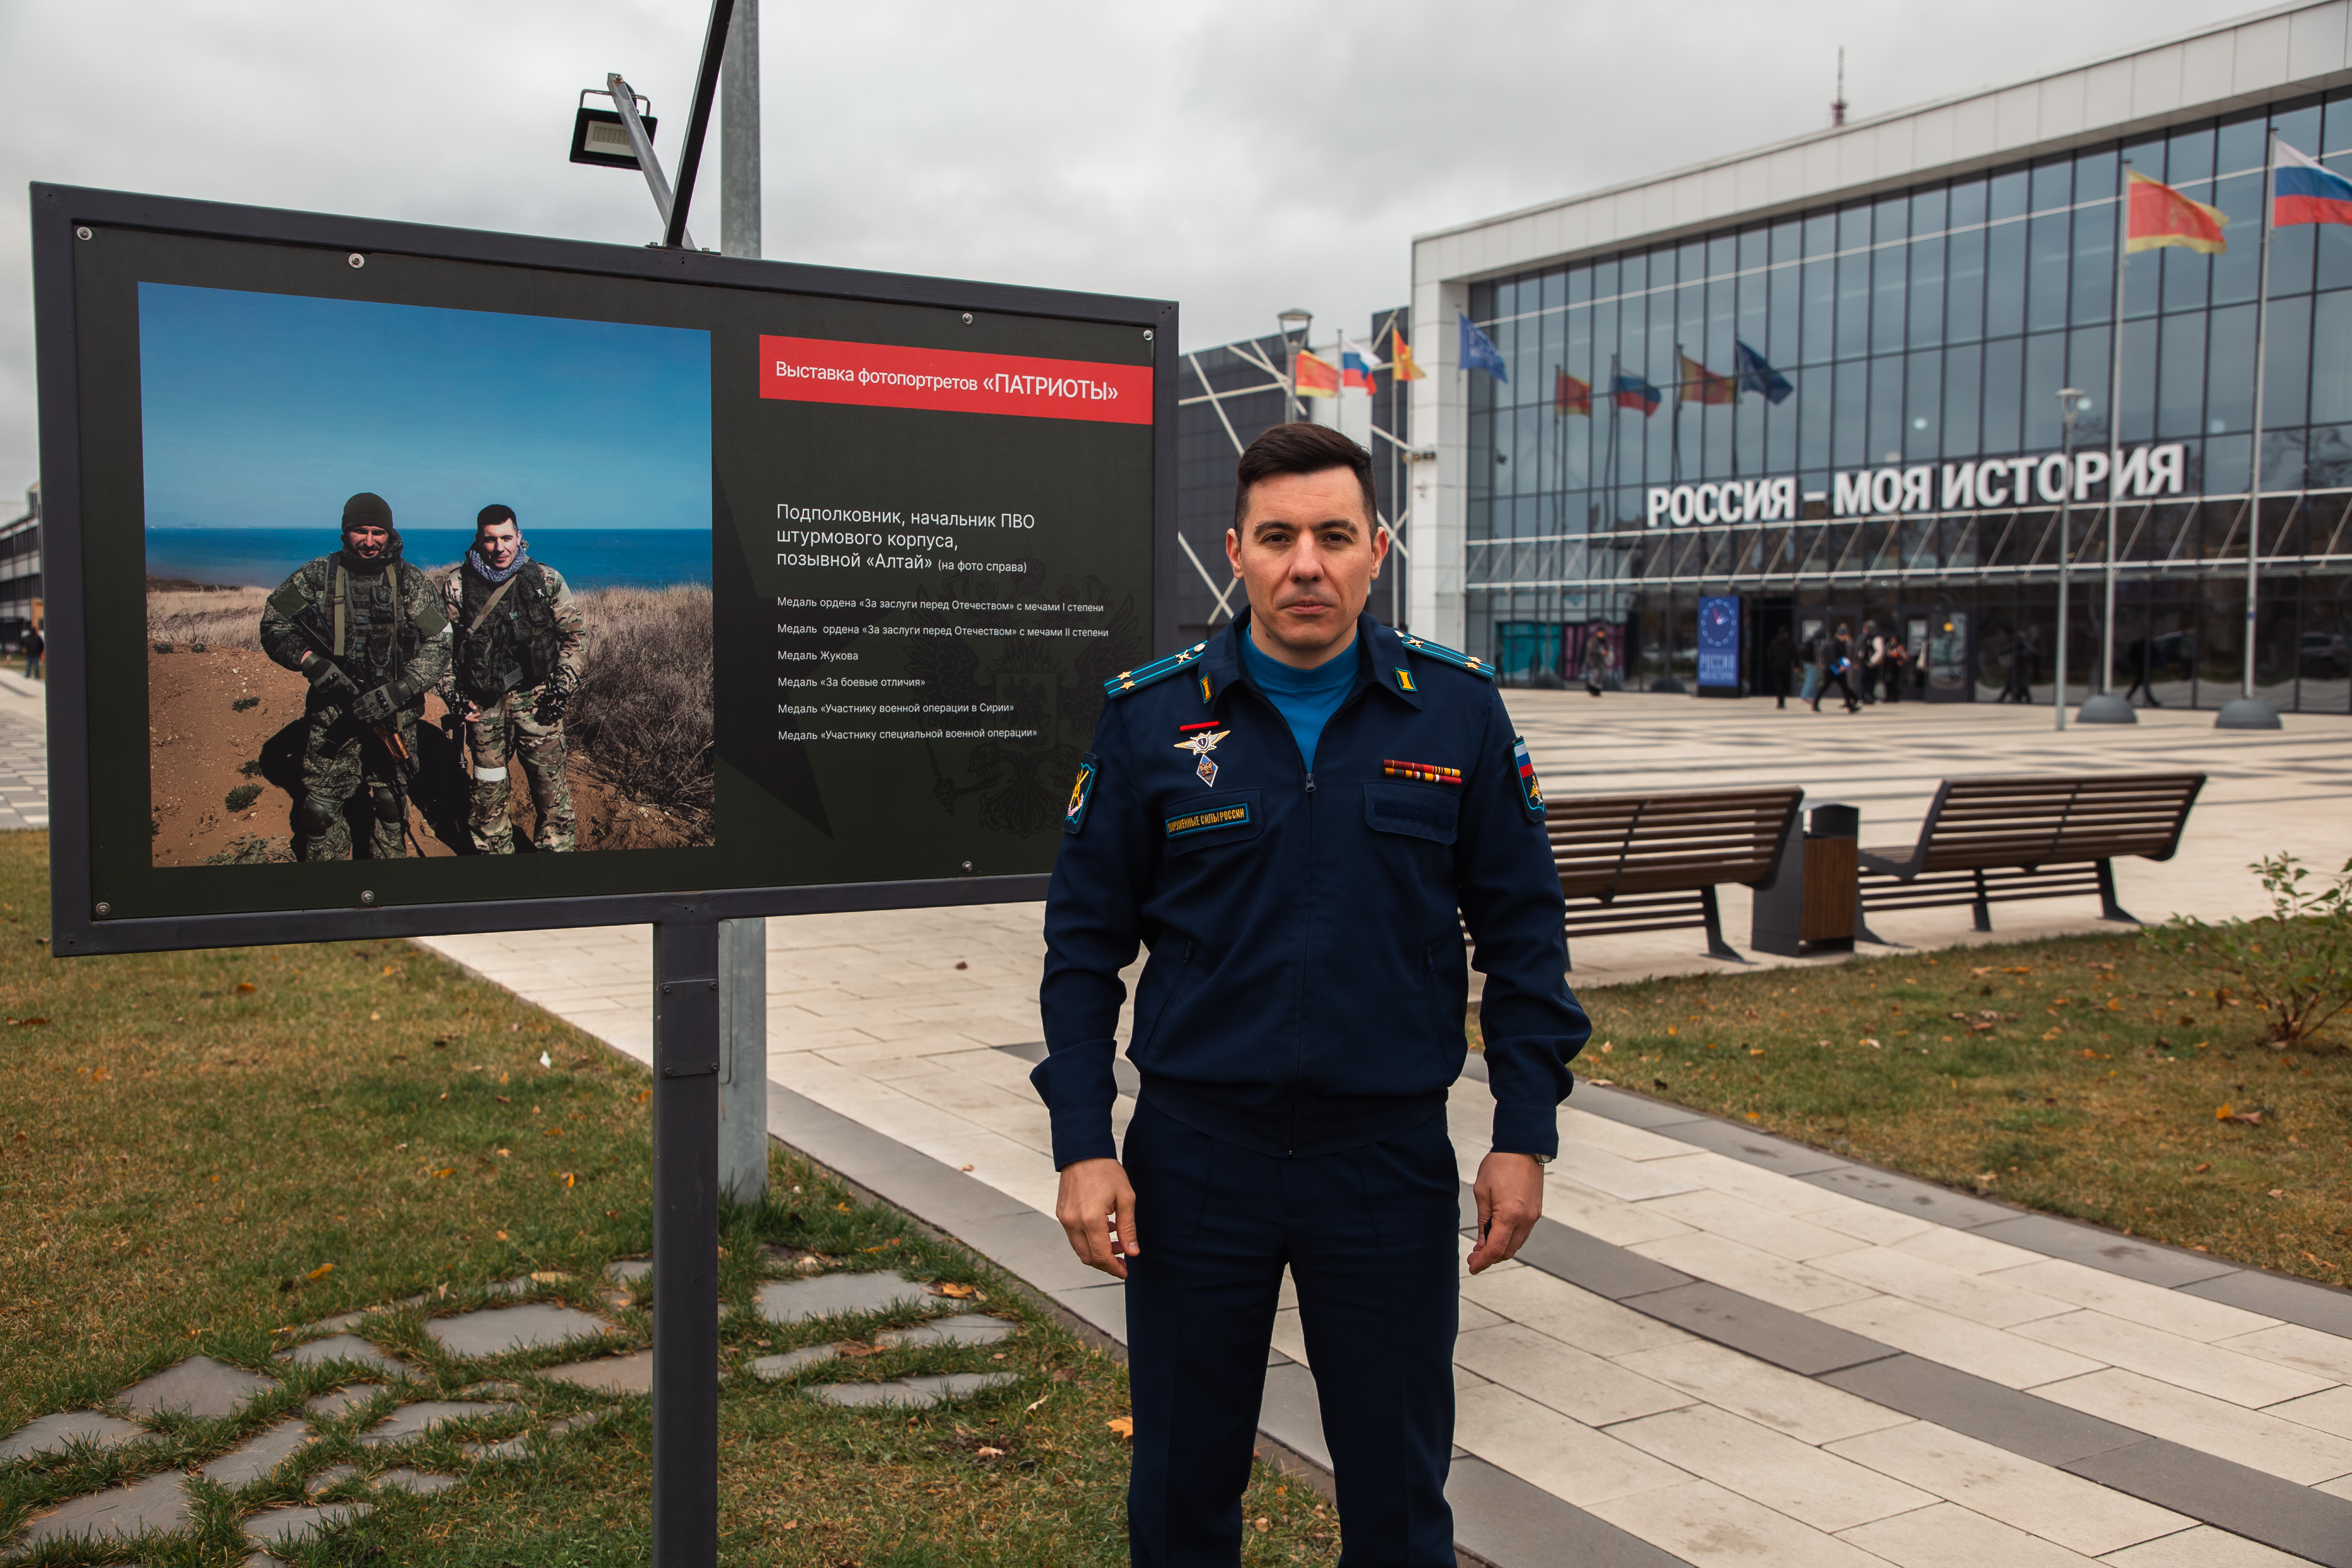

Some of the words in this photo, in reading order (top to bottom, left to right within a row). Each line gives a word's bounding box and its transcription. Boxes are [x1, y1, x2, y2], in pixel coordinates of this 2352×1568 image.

[776, 361, 854, 382] Выставка
[858, 368, 978, 392] фотопортретов
[983, 373, 1118, 400] «ПАТРИОТЫ»
[1648, 476, 1796, 527] РОССИЯ
[1834, 466, 1933, 515] МОЯ
[1942, 444, 2185, 510] ИСТОРИЯ
[777, 504, 905, 527] Подполковник,
[911, 513, 996, 527] начальник
[1001, 513, 1035, 529] ПВО
[777, 530, 882, 547] штурмового
[888, 534, 958, 551] корпуса,
[778, 551, 860, 567] позывной
[867, 553, 932, 569] «Алтай»
[938, 559, 954, 571] (на
[957, 560, 983, 572] фото
[986, 562, 1027, 574] справа)
[778, 597, 817, 608] Медаль
[820, 600, 856, 609] ордена
[859, 598, 876, 608] «За
[879, 600, 917, 610] заслуги
[920, 601, 949, 611] перед
[952, 600, 1014, 610] Отечеством»
[778, 624, 817, 635] Медаль
[823, 626, 859, 636] ордена
[862, 625, 879, 634] «За
[882, 627, 920, 637] заслуги
[923, 628, 952, 637] перед
[955, 626, 1017, 636] Отечеством»
[778, 650, 817, 662] Медаль
[820, 651, 858, 662] Жукова
[778, 677, 818, 688] Медаль
[821, 677, 838, 686] «За
[841, 677, 878, 686] боевые
[778, 704, 818, 715] Медаль
[821, 704, 876, 715] «Участнику
[879, 703, 920, 713] военной
[923, 705, 969, 714] операции
[980, 703, 1014, 714] Сирии»
[778, 731, 818, 741] Медаль
[821, 730, 876, 741] «Участнику
[879, 729, 943, 740] специальной
[946, 729, 985, 738] военной
[987, 730, 1037, 739] операции»
[1200, 812, 1219, 824] СИЛЫ
[1219, 808, 1244, 821] РОССИИ
